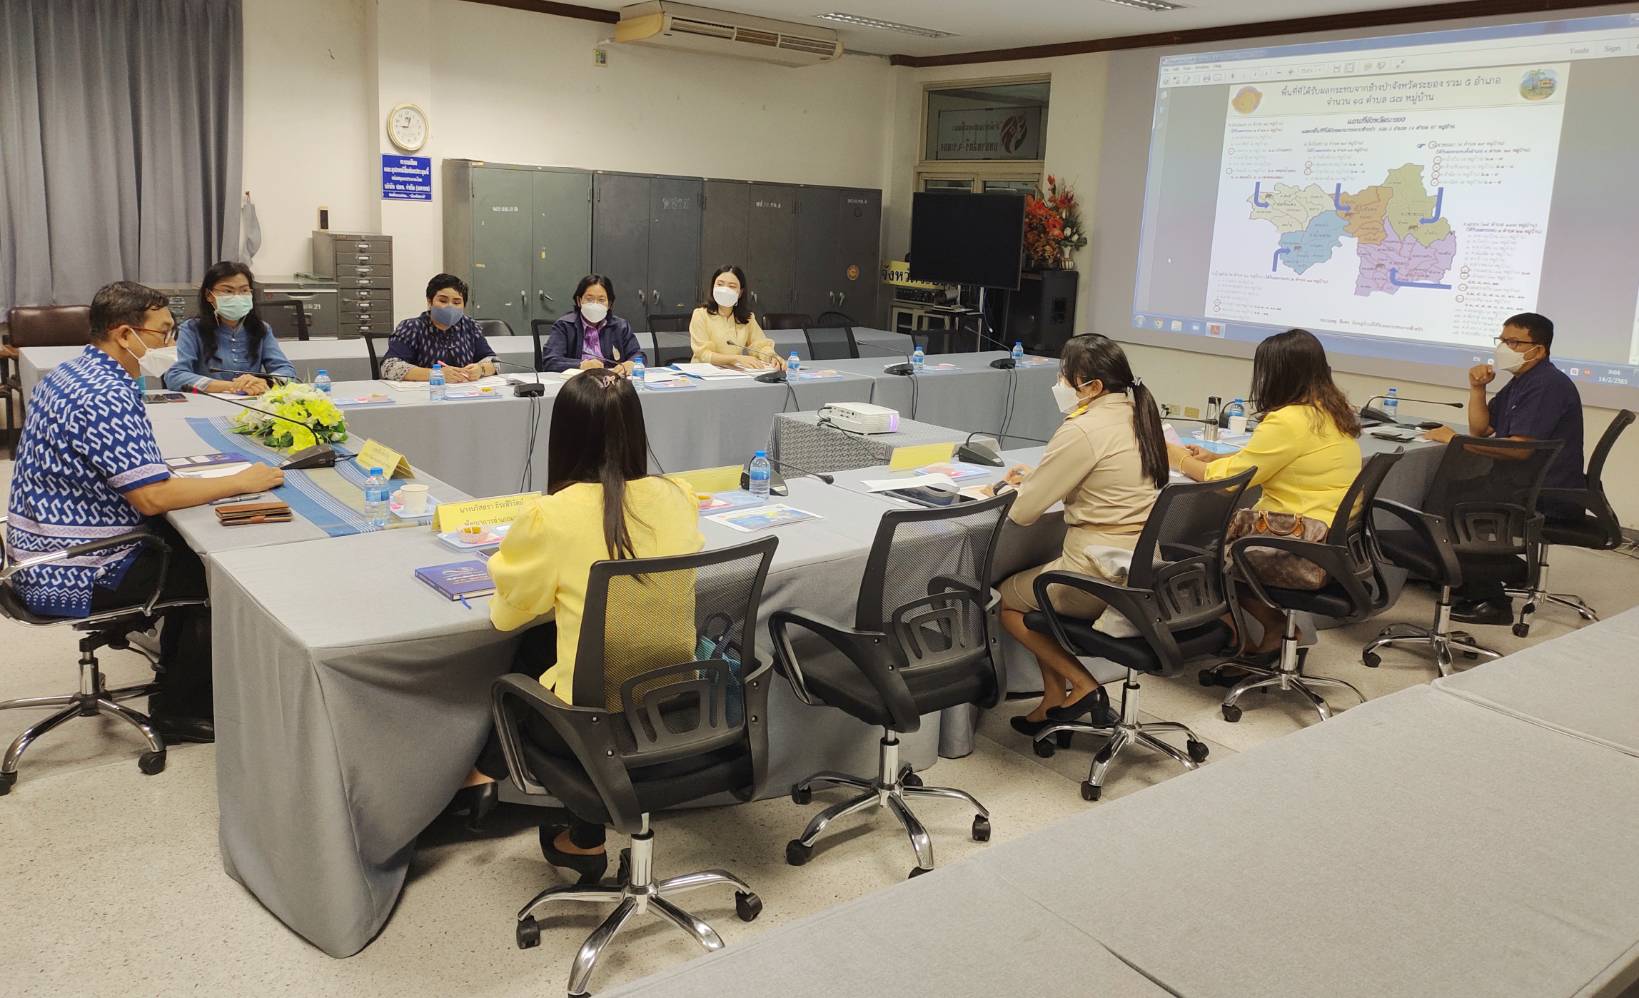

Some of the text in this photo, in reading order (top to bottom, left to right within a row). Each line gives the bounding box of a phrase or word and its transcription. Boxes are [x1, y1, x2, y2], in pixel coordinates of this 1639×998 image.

[1474, 75, 1502, 86] อำเภอ
[1366, 94, 1387, 104] ตำบล
[1405, 92, 1434, 105] หมู่บ้าน
